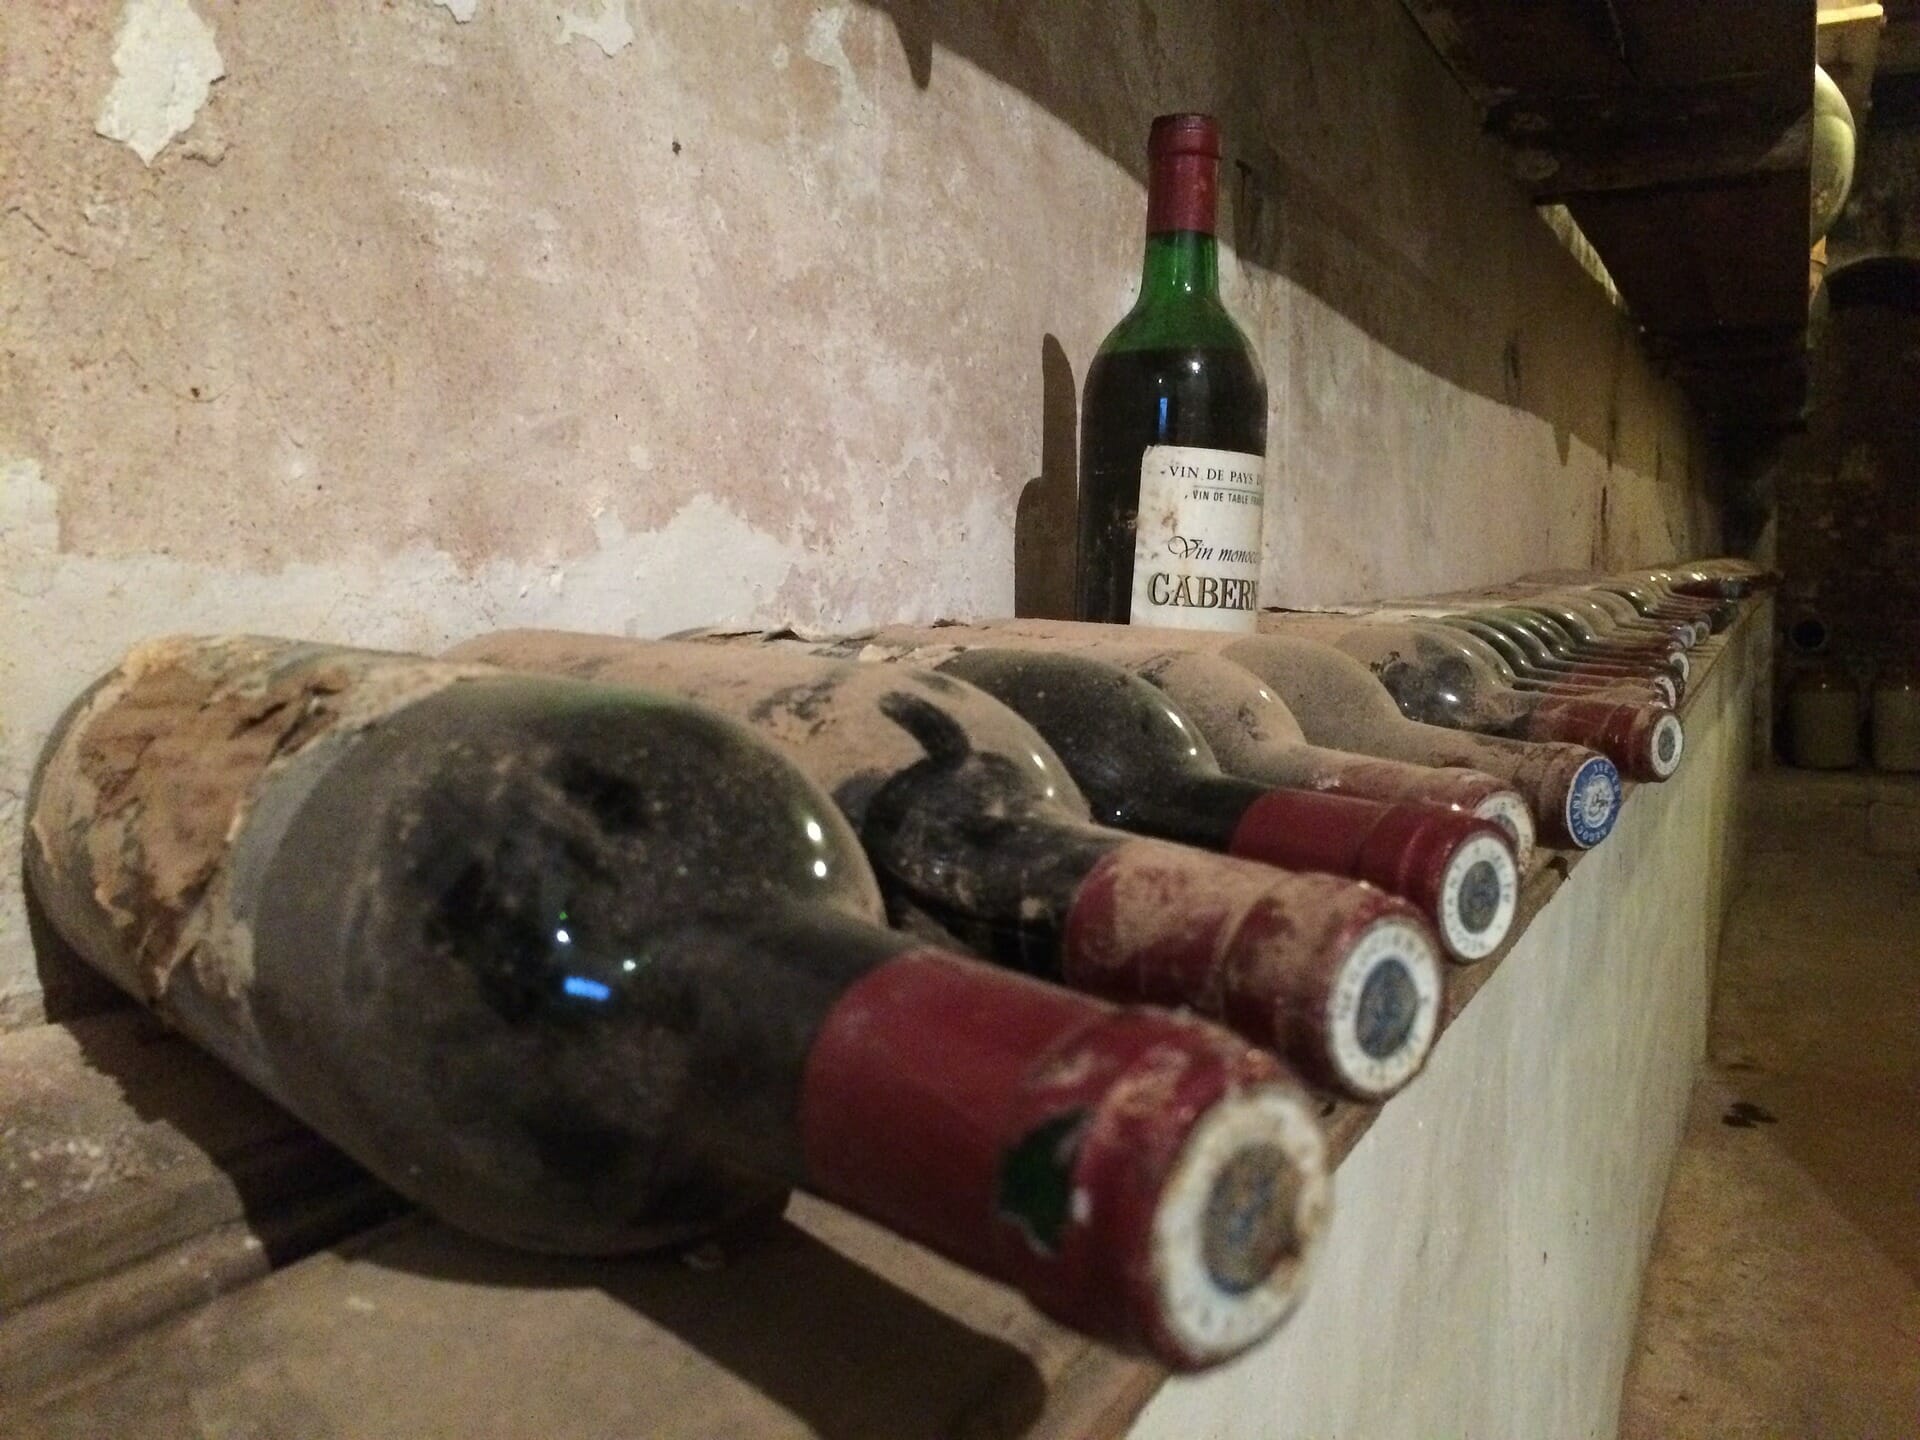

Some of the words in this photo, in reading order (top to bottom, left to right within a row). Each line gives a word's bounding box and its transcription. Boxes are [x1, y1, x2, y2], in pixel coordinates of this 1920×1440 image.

[1169, 465, 1199, 479] VIN
[1207, 468, 1224, 481] DE
[1230, 471, 1253, 485] PAYS
[1192, 489, 1210, 501] VIN
[1213, 490, 1224, 502] DE
[1228, 493, 1249, 505] TABLE
[1167, 535, 1213, 560] Vin
